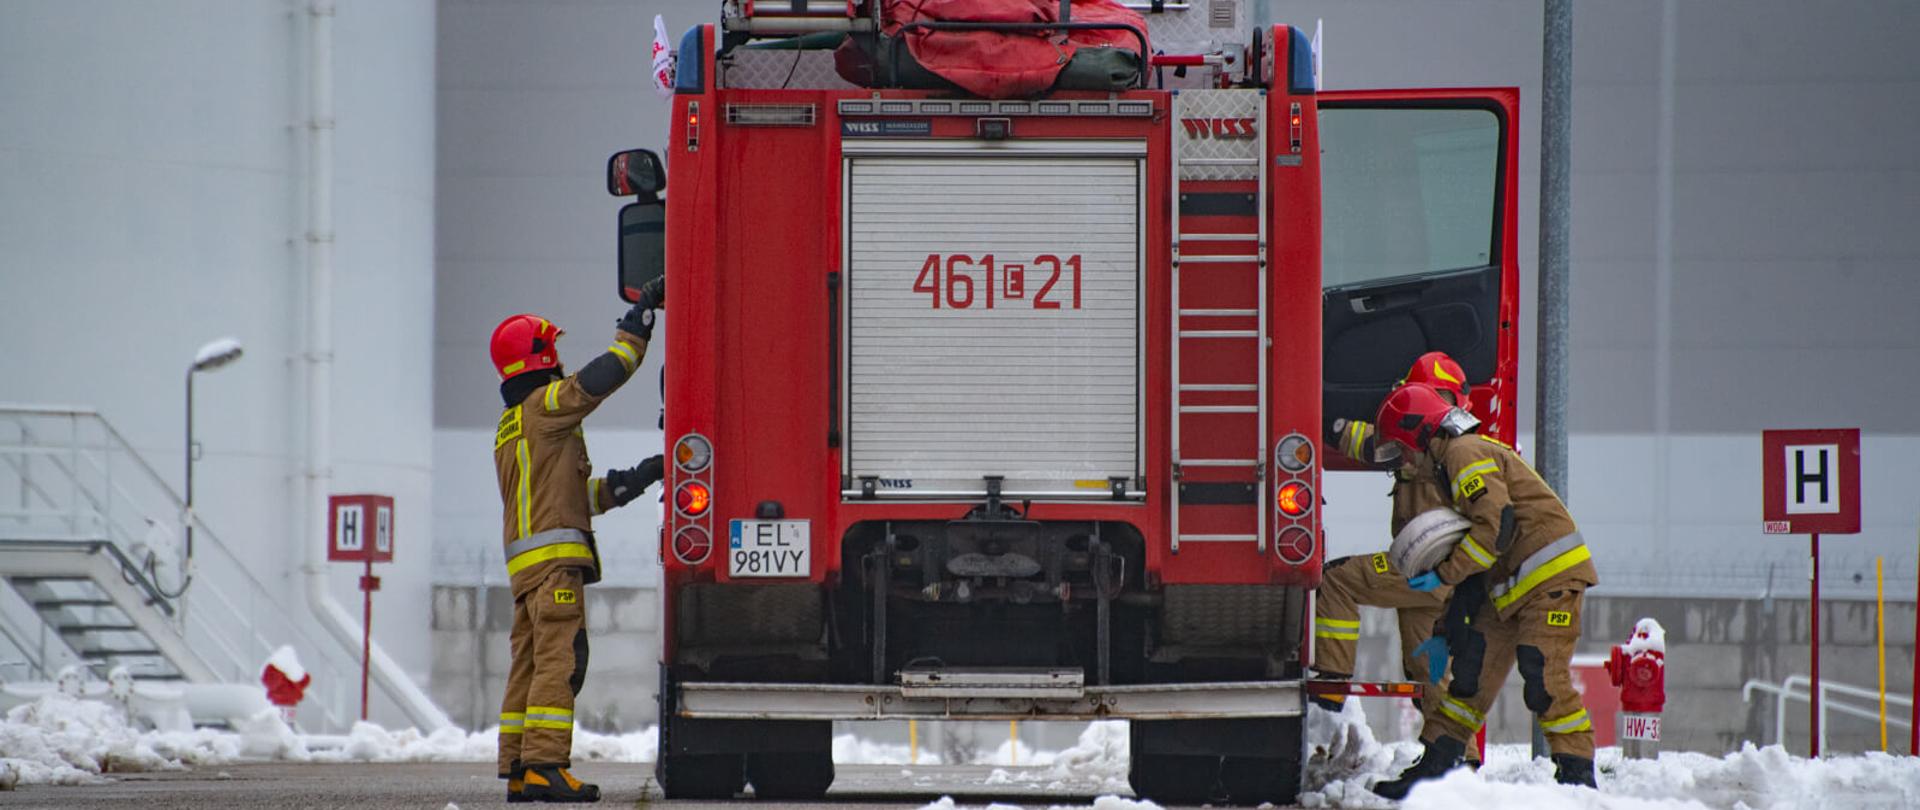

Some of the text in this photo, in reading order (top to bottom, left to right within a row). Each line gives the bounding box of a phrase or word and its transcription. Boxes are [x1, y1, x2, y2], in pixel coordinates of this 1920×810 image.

[844, 122, 880, 132] WISS
[1180, 117, 1257, 141] WISS
[912, 253, 1082, 310] 461 E 21
[879, 479, 913, 488] WISS
[1463, 478, 1480, 495] PSP
[1795, 449, 1829, 504] H
[343, 509, 357, 546] H
[378, 510, 387, 547] H
[756, 523, 790, 546] EL
[1766, 521, 1789, 532] WODA
[735, 549, 804, 574] 981VY
[557, 591, 575, 601] PSP
[1550, 613, 1568, 624] PSP
[1626, 717, 1660, 739] HW-3
